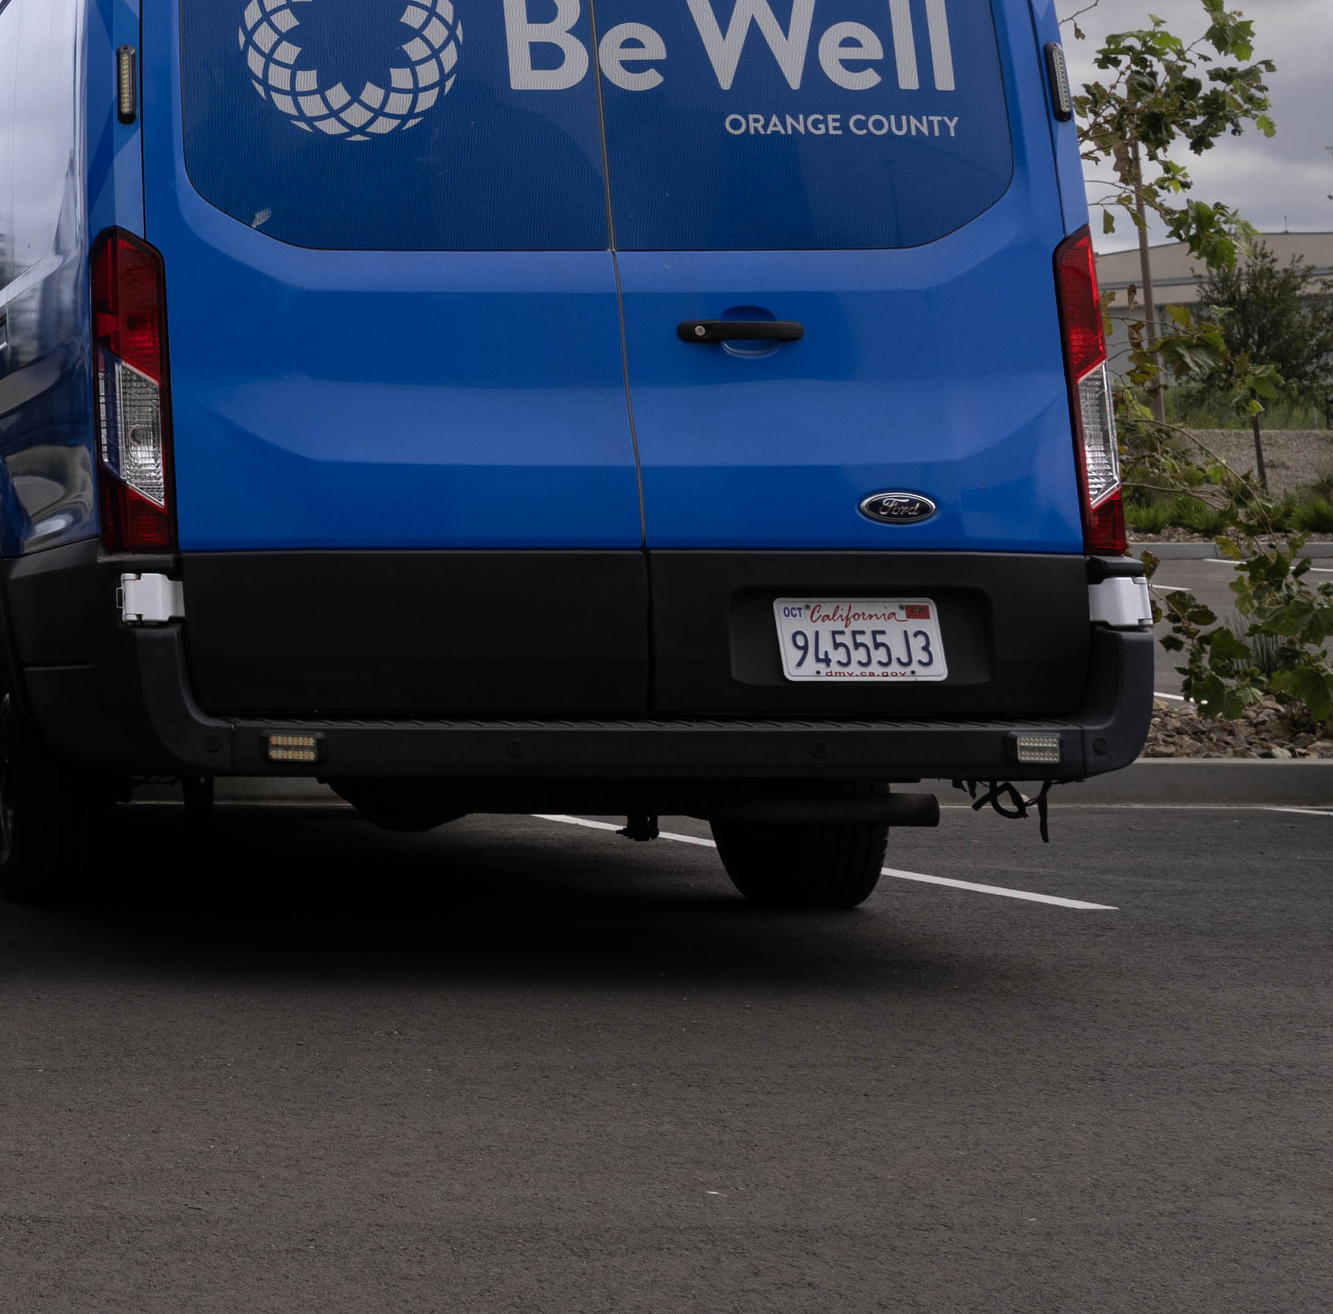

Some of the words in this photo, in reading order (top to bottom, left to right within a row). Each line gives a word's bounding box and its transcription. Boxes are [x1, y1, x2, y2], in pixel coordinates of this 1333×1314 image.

[724, 113, 843, 136] ORANGE
[848, 114, 959, 137] COUNTY
[879, 497, 920, 515] Ford
[783, 606, 803, 618] OCT
[810, 604, 909, 628] California
[791, 630, 933, 667] 94555J3
